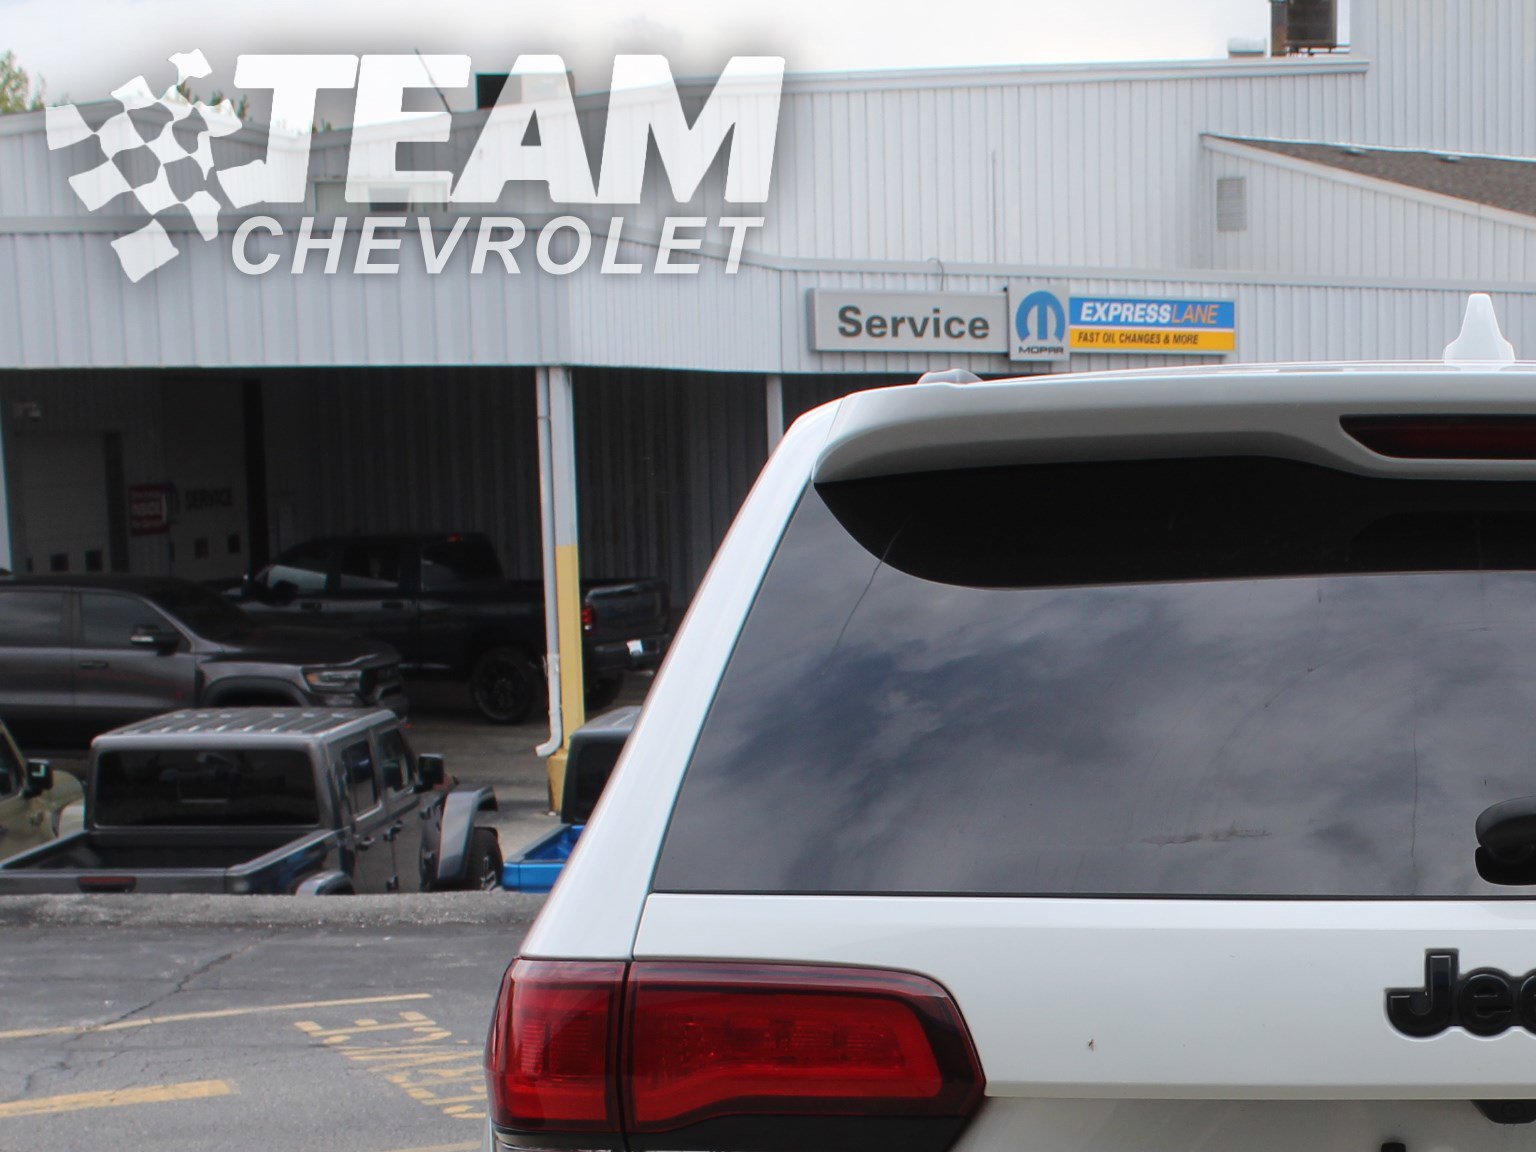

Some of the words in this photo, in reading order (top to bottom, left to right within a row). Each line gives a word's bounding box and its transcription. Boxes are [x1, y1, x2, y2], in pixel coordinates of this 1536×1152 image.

[836, 304, 991, 340] Service
[1077, 331, 1100, 344] FAST
[1102, 332, 1116, 345] OIL
[1118, 333, 1161, 345] CHANGES
[1163, 334, 1170, 345] &
[1172, 333, 1199, 345] MORE
[1018, 346, 1064, 355] MOPAR
